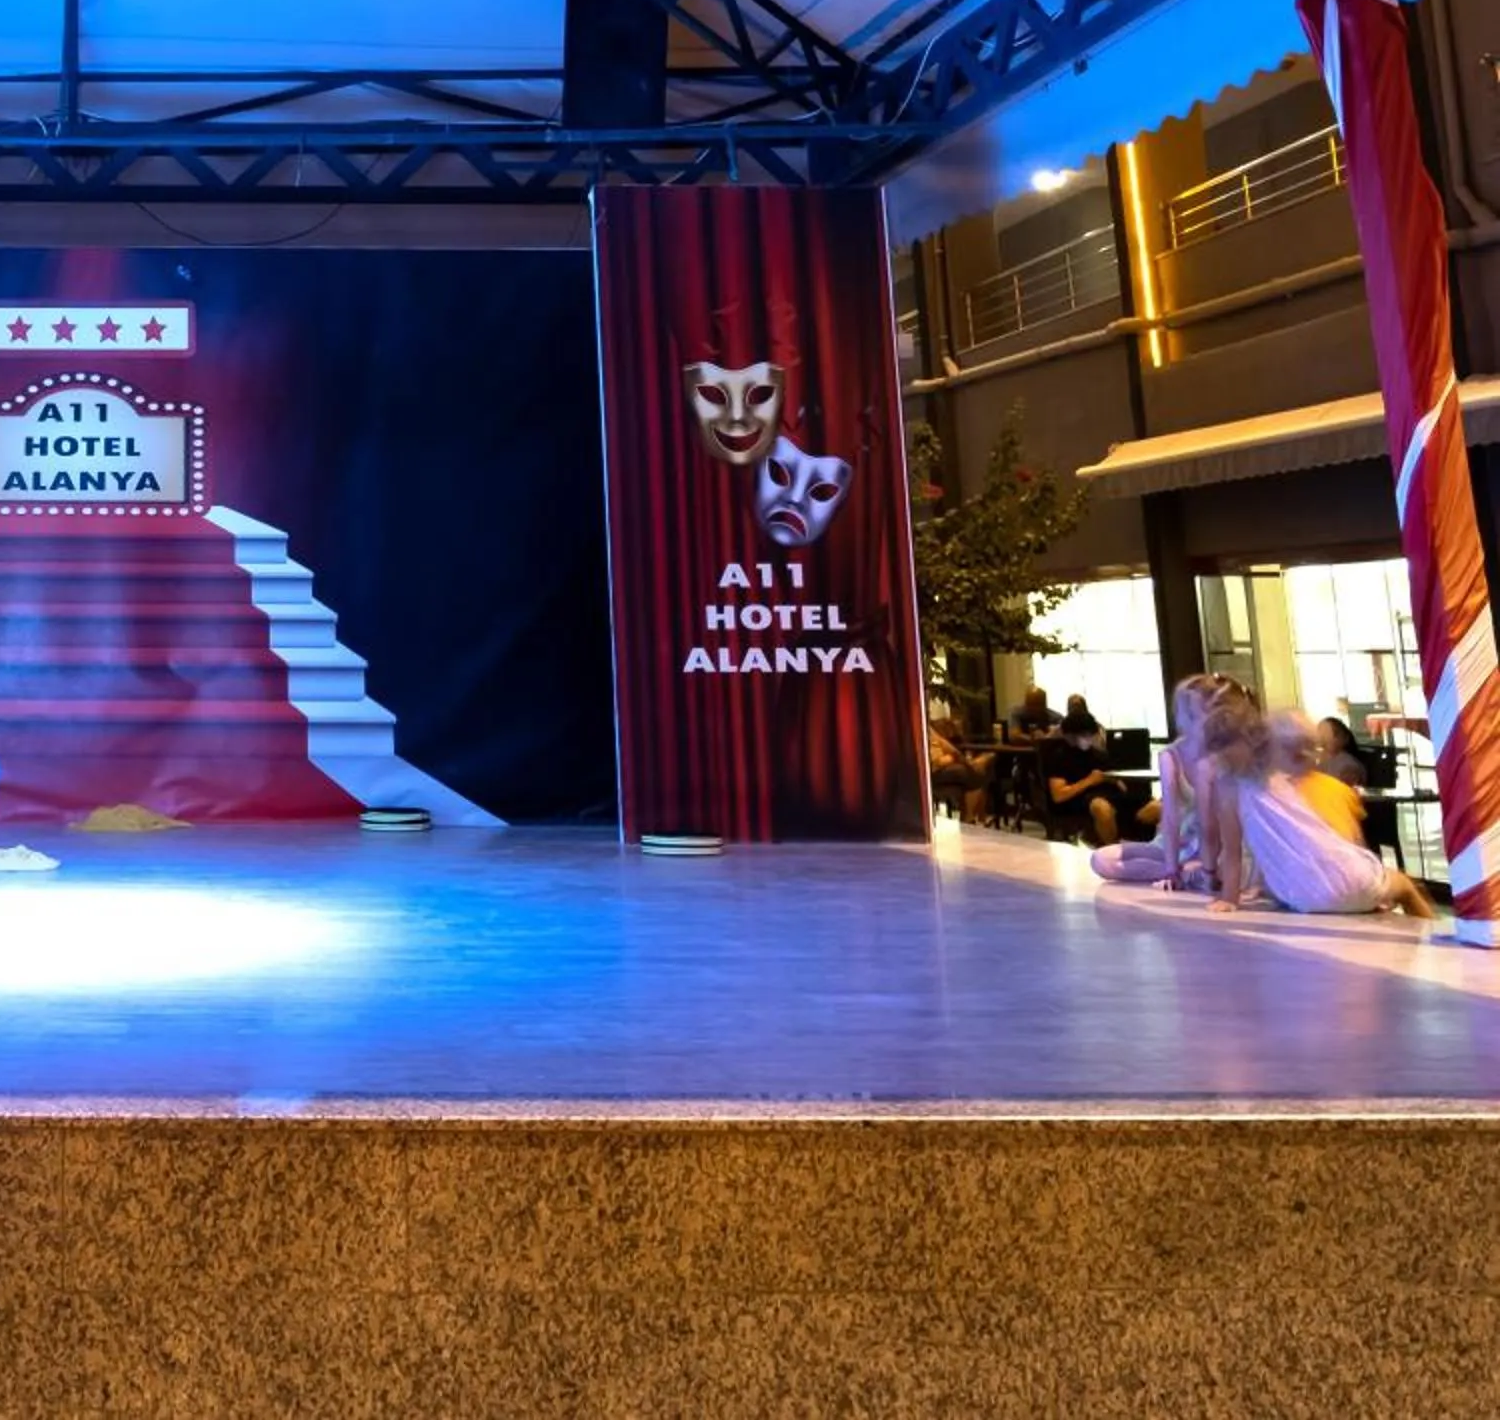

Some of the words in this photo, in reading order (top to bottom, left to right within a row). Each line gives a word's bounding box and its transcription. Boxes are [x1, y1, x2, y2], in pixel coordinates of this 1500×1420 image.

[38, 402, 108, 423] A11
[24, 435, 141, 457] HOTEL
[2, 470, 161, 492] ALANYA
[718, 563, 804, 588] A11
[705, 604, 848, 631] HOTEL
[683, 646, 875, 673] ALANYA
